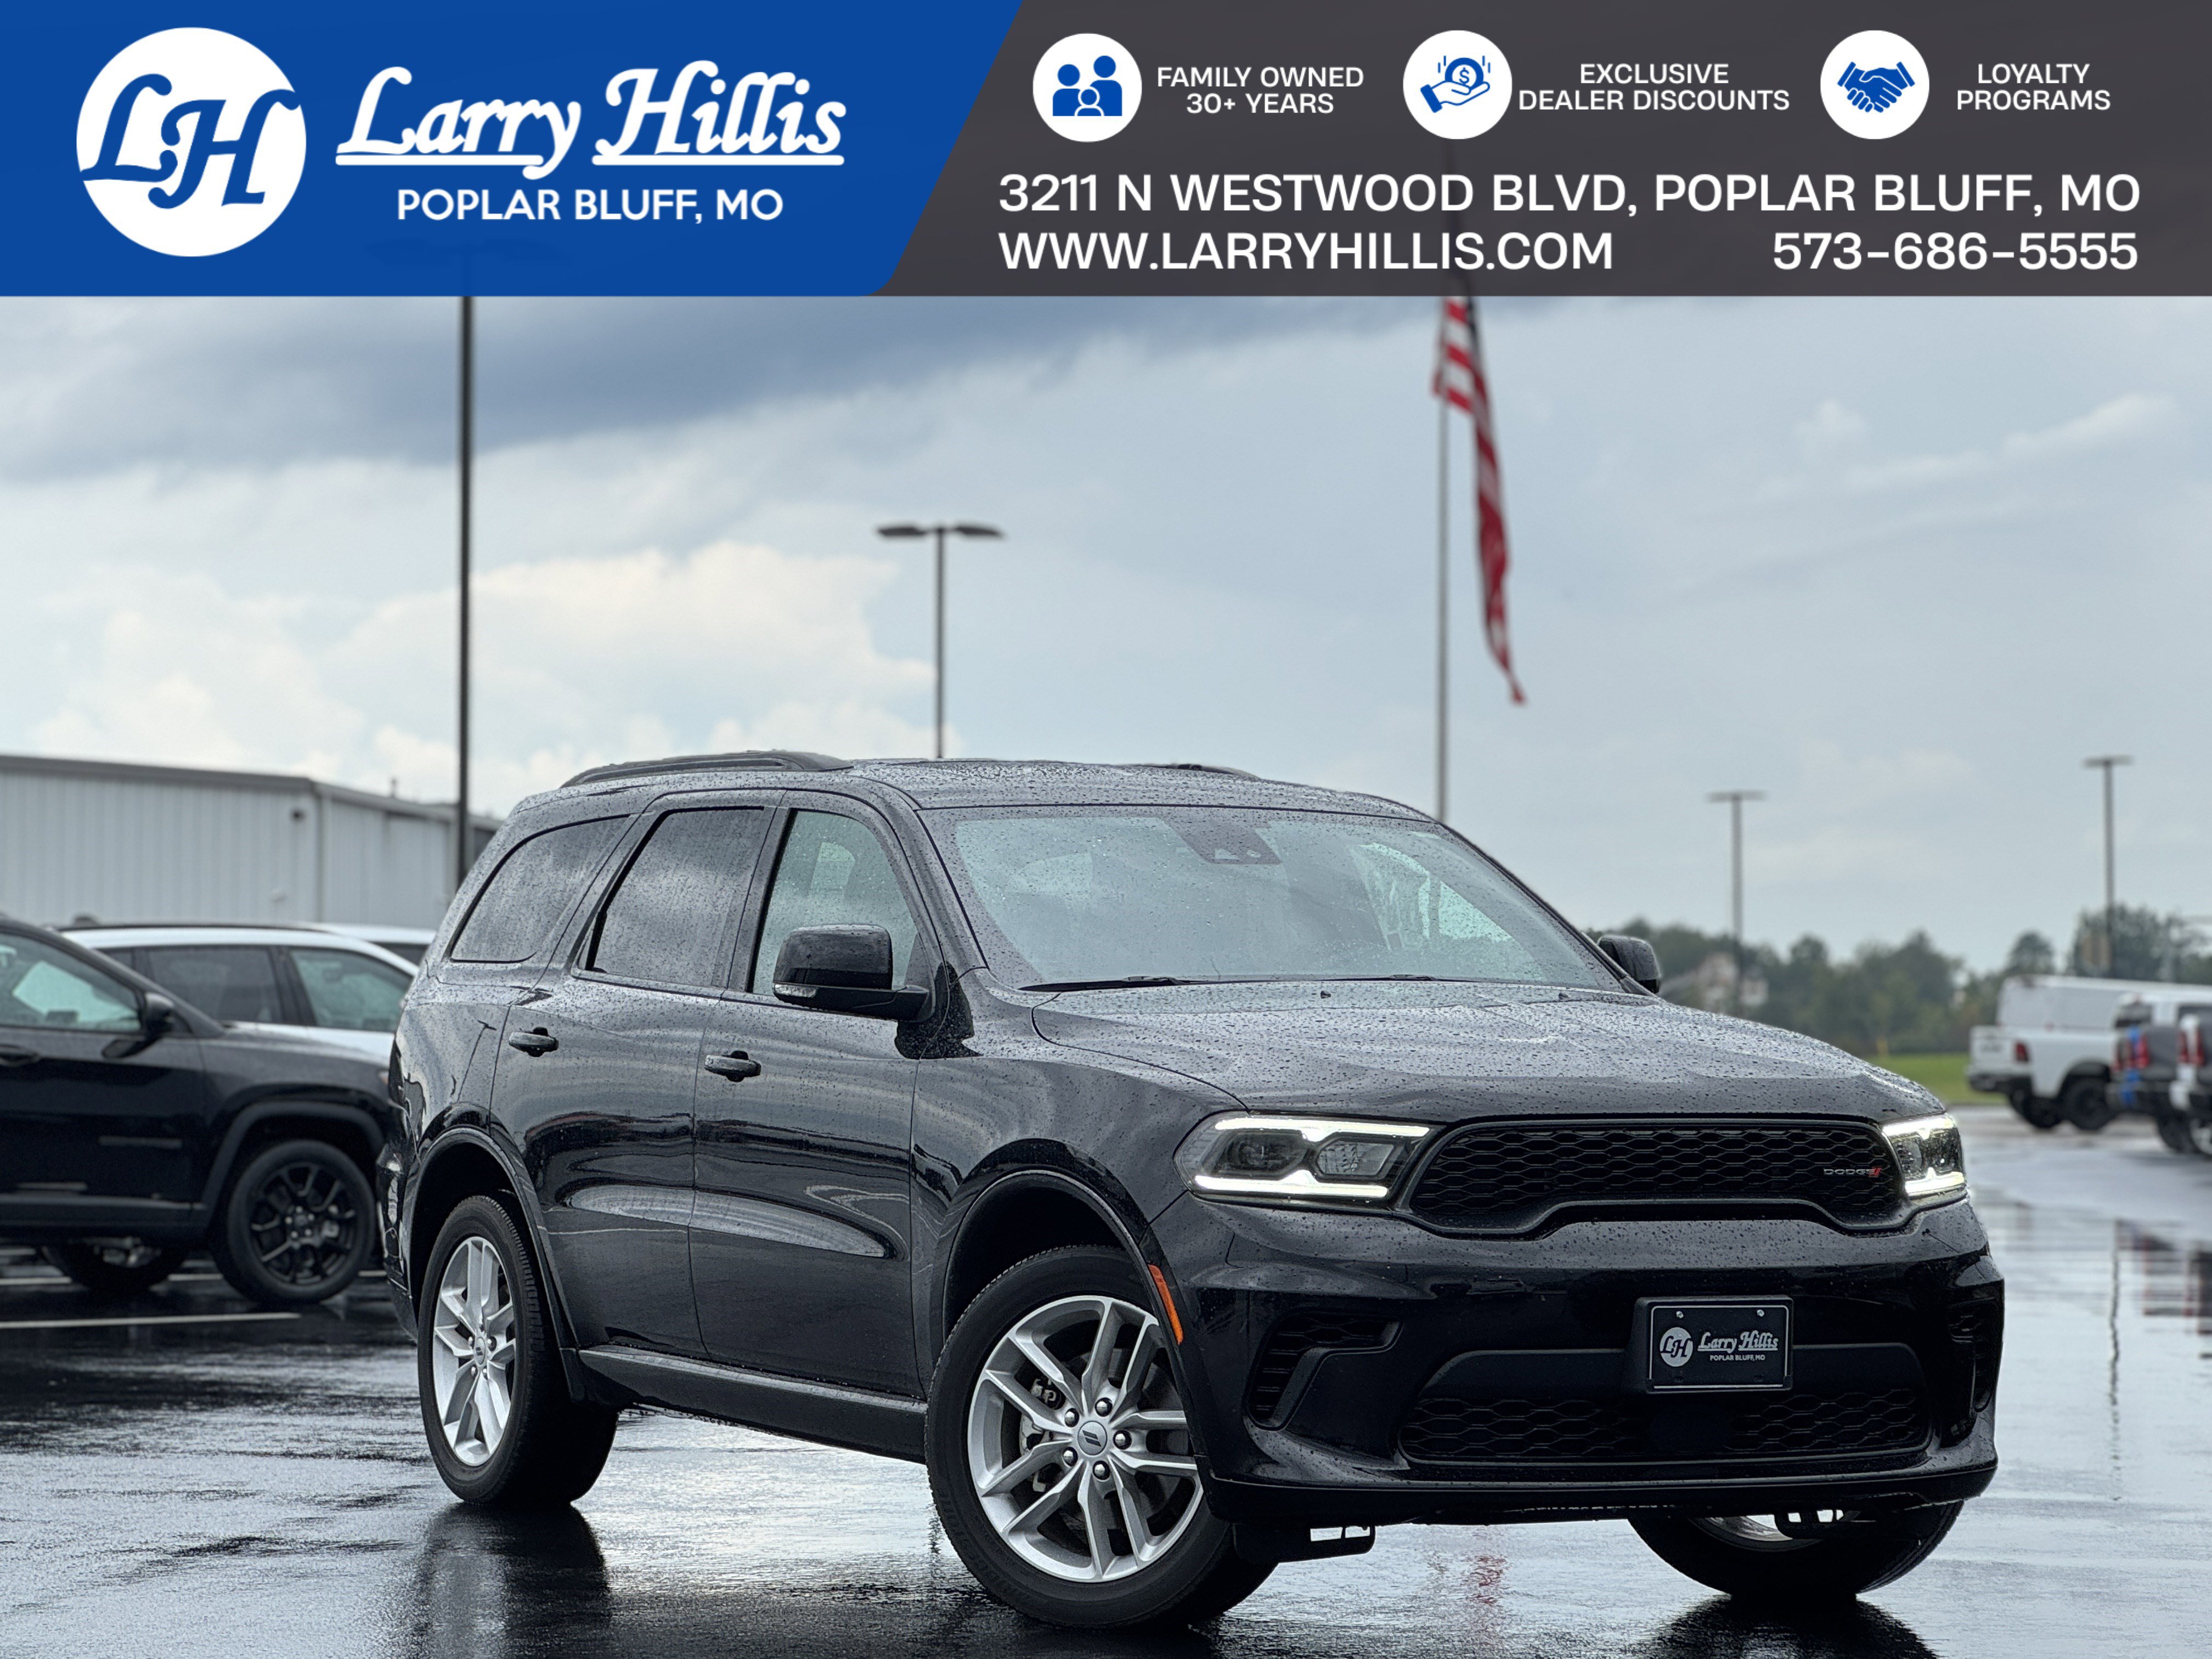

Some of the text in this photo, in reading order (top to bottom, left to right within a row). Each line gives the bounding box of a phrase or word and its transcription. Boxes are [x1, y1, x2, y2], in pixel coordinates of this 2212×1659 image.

[1823, 1168, 1877, 1177] DODGE
[1698, 1330, 1779, 1354] Larry Hillis
